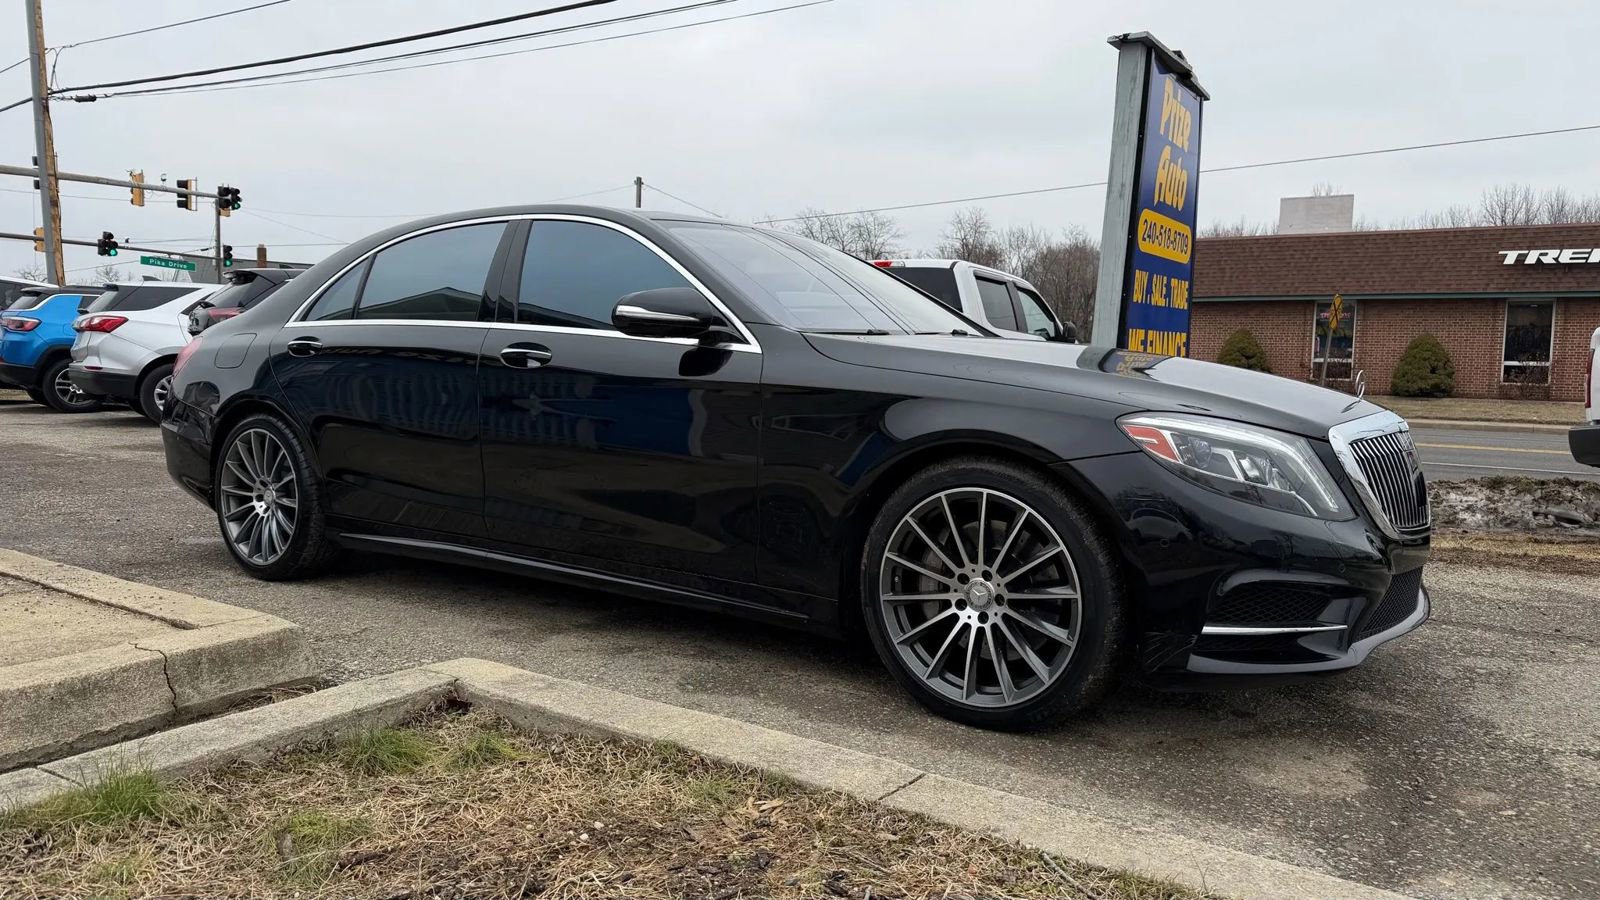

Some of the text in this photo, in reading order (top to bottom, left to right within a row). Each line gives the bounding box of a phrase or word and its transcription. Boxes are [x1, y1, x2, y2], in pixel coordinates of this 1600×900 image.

[1160, 77, 1191, 153] Prize
[1154, 144, 1188, 211] Auto
[168, 261, 187, 269] Drive
[1171, 277, 1189, 310] TRADE
[1128, 328, 1187, 357] WE FINANCE
